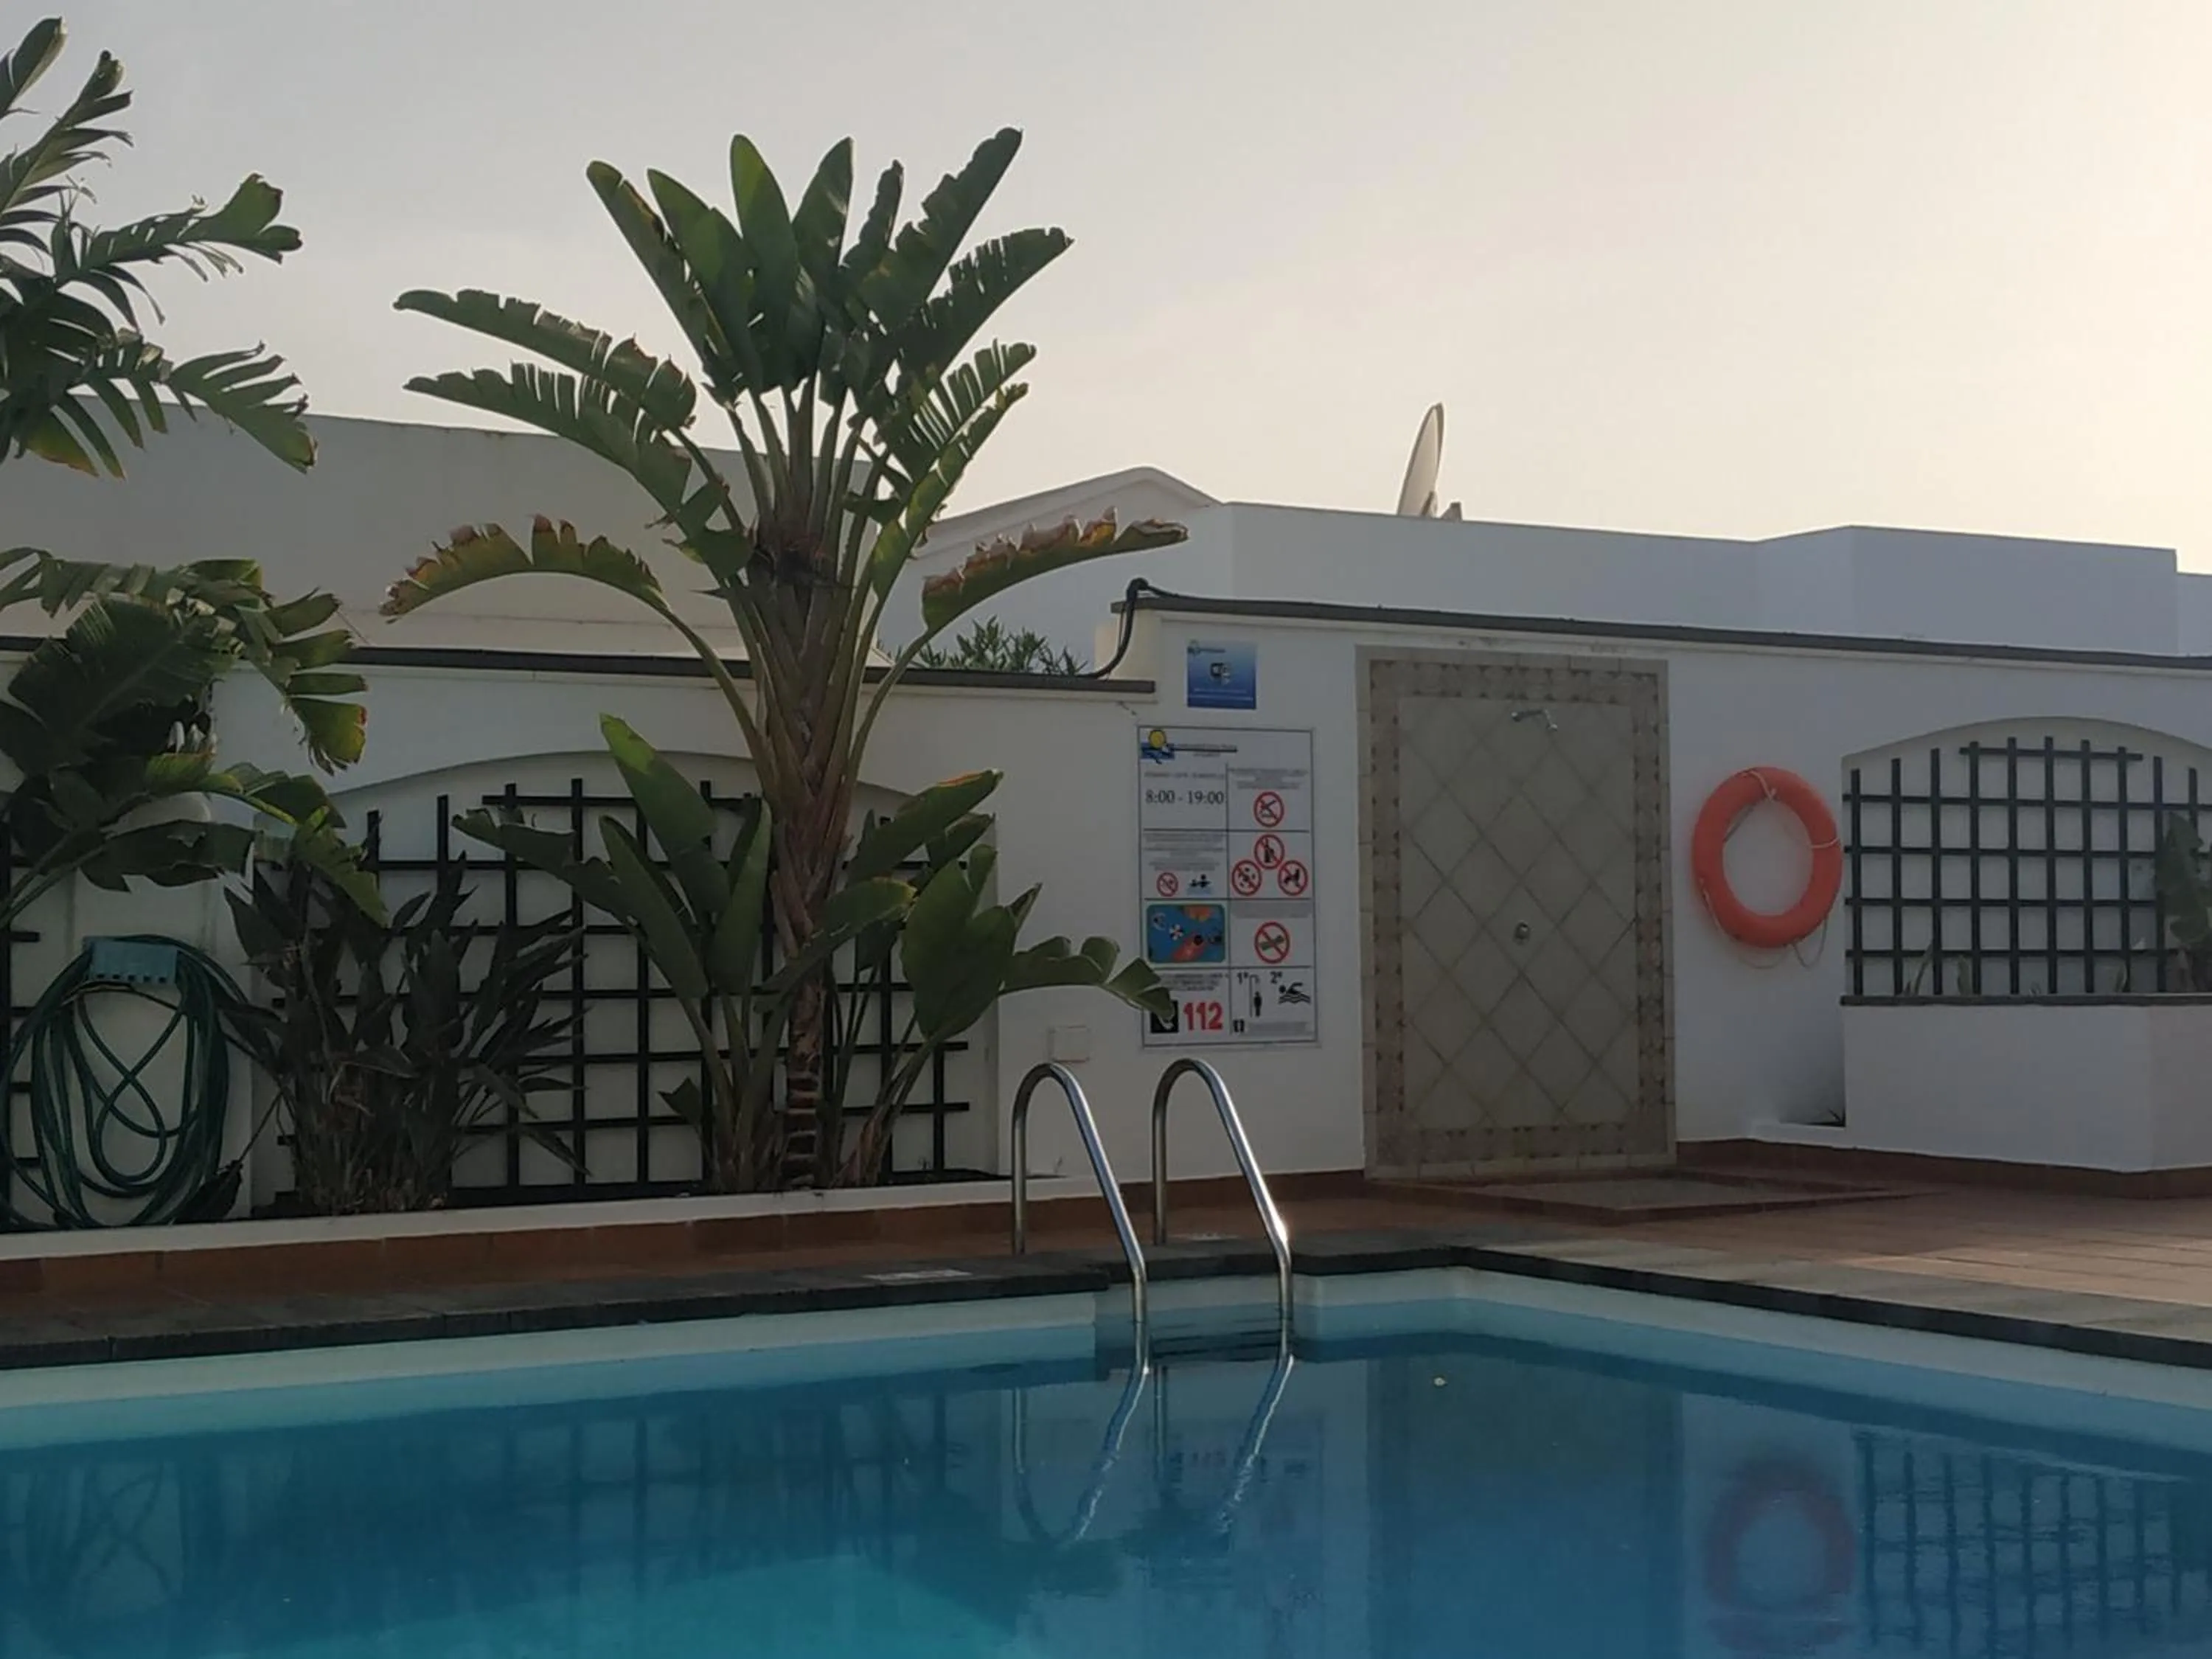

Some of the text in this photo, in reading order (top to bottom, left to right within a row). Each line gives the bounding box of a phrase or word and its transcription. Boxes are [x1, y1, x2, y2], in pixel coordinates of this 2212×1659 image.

[1145, 790, 1175, 804] 8:00
[1187, 790, 1225, 804] 19:00
[1183, 1001, 1224, 1031] 112
